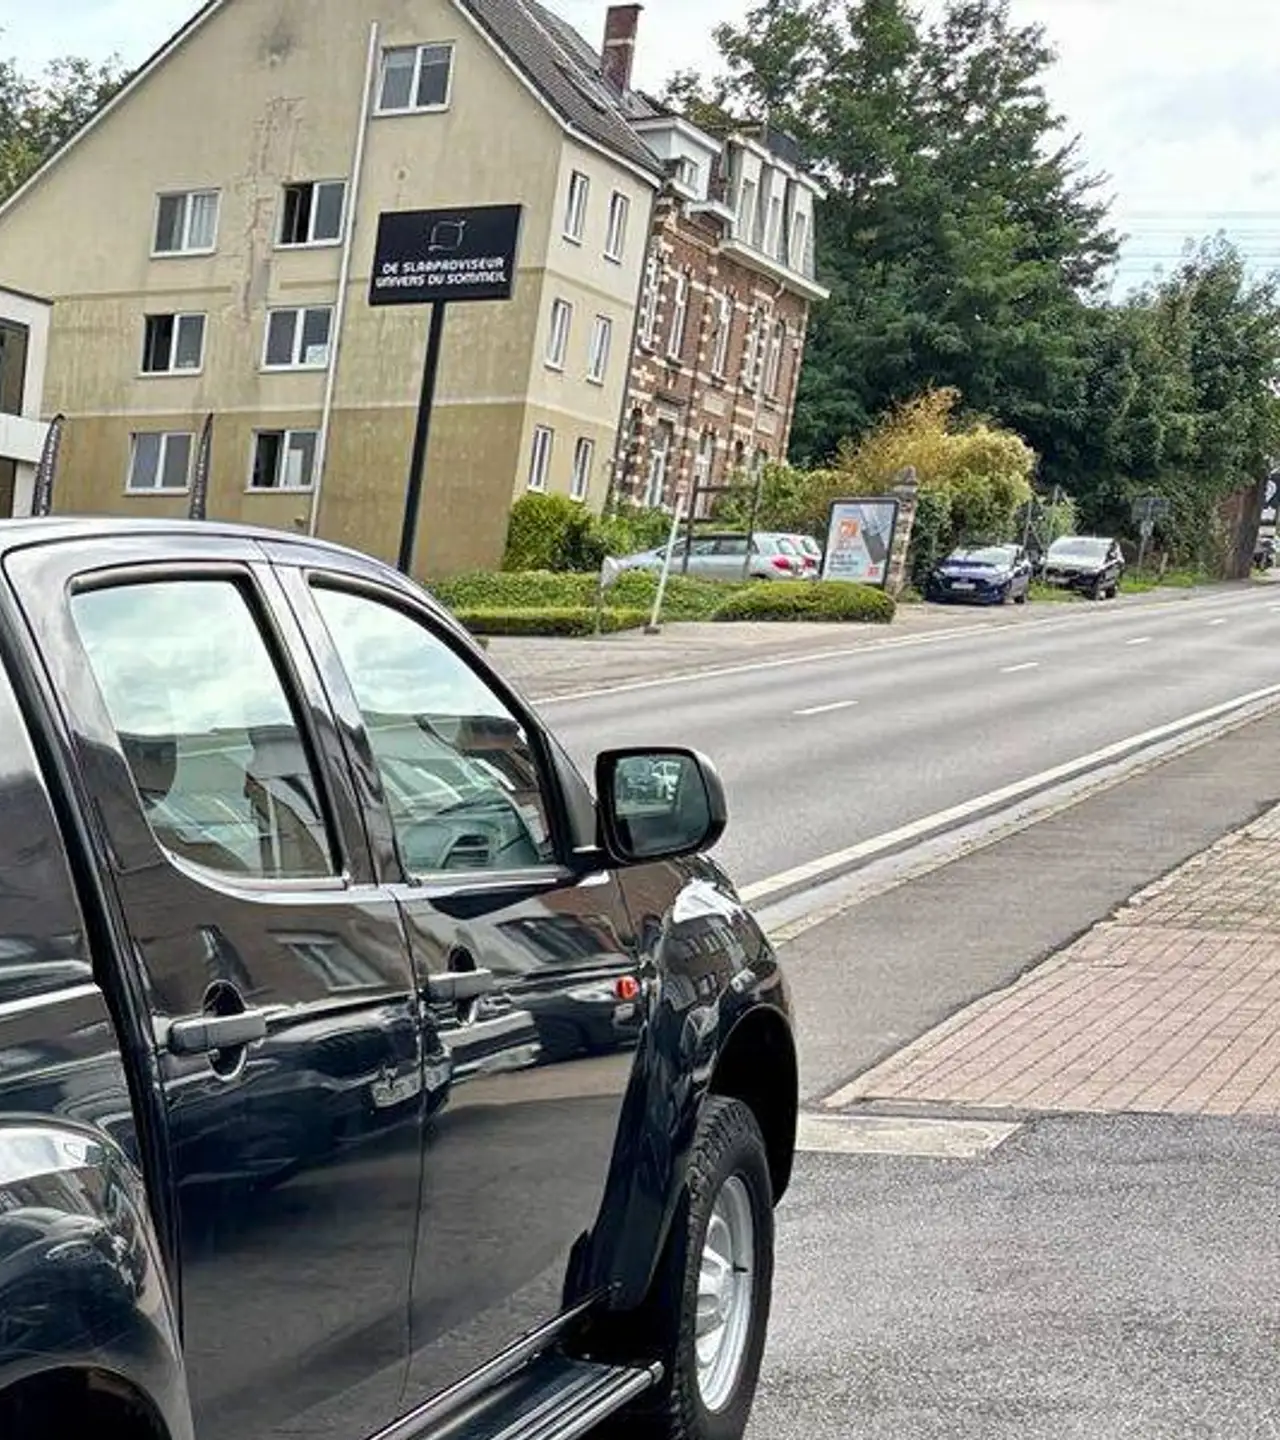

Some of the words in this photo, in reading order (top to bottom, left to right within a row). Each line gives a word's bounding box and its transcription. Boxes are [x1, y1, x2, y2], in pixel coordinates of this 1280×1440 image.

[382, 261, 398, 275] DE
[428, 273, 445, 286] DU
[446, 271, 507, 286] SOMMEIL
